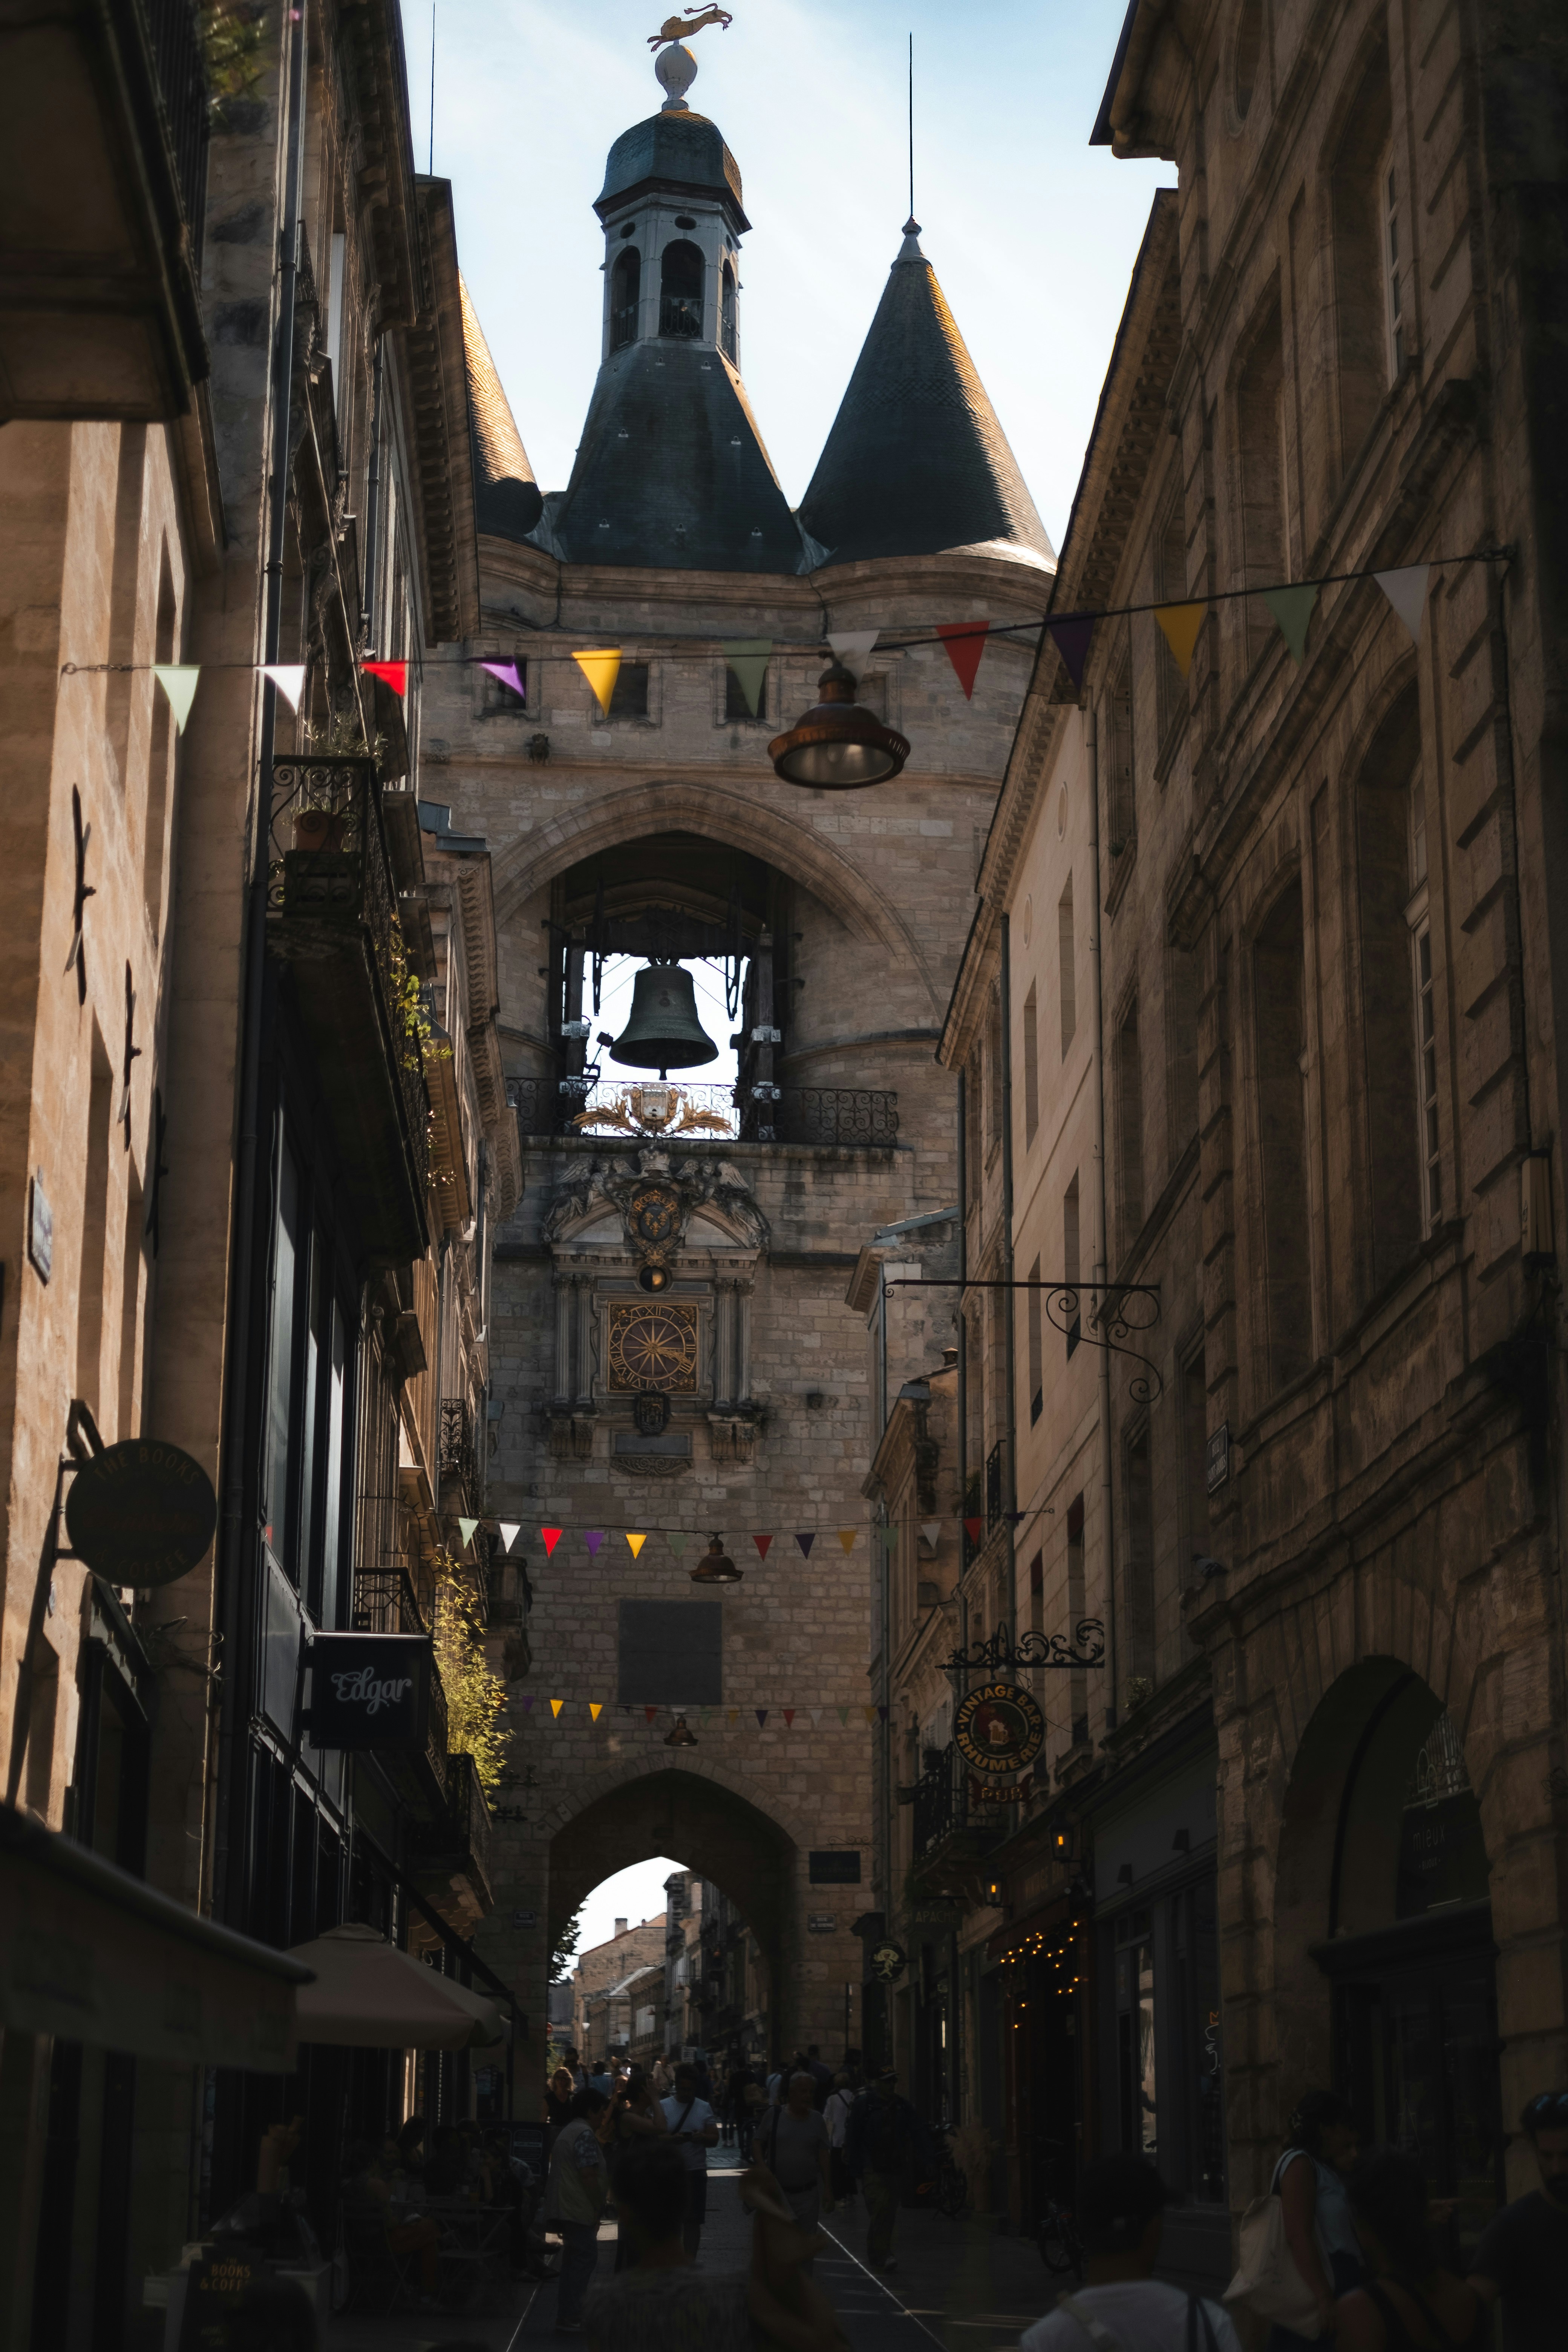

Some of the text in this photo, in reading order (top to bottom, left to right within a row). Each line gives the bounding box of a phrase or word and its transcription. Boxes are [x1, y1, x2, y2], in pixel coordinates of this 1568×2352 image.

[645, 1306, 662, 1316] XII
[93, 1451, 130, 1481] THE
[139, 1447, 201, 1484] BOOKS
[117, 1548, 188, 1579] COFFEE
[331, 1666, 412, 1715] Edgar
[957, 1685, 1042, 1726] VINTAGE BAR
[956, 1731, 1042, 1772] RHUMERIE
[981, 1786, 1023, 1802] PUB
[1413, 1823, 1446, 1851] mieux
[1422, 1856, 1437, 1870] BIJOUX
[916, 1911, 959, 1923] APACHE
[211, 2263, 251, 2278] BOOKS
[200, 2277, 209, 2290] &
